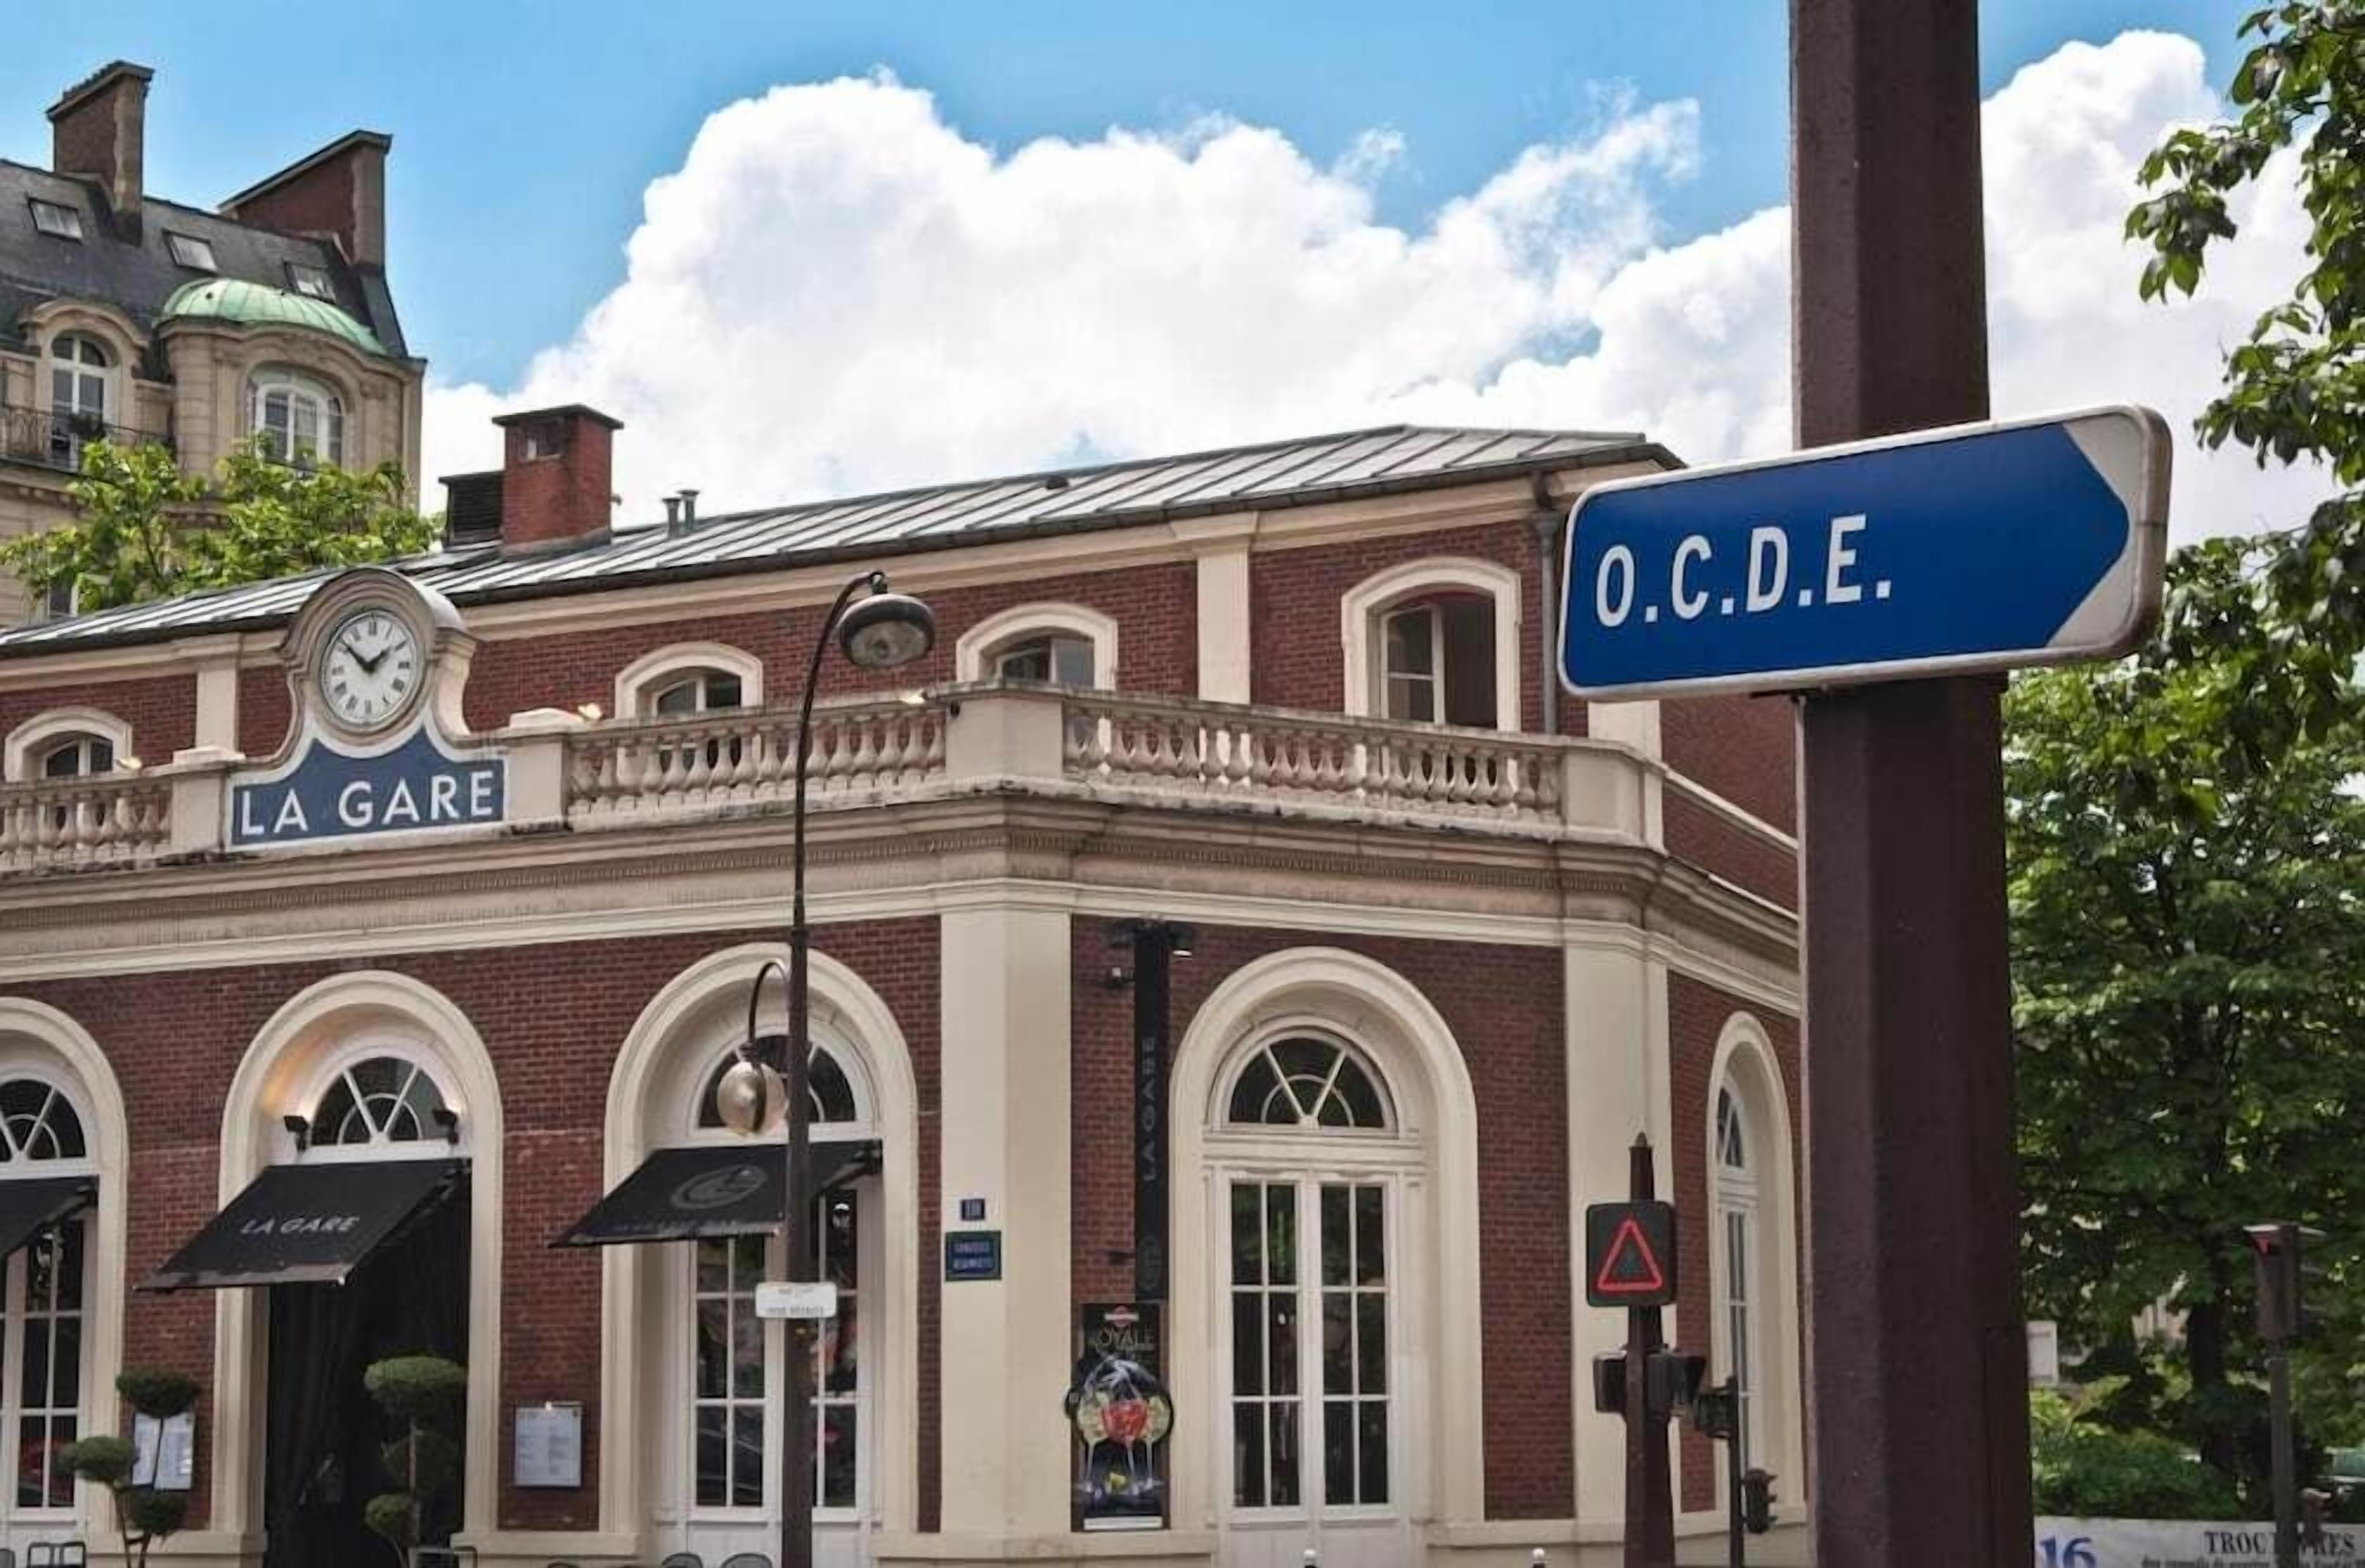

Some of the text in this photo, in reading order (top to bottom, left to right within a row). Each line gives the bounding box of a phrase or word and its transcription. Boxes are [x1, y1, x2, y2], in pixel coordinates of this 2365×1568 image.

[1596, 513, 1891, 627] O.C.D.E.
[241, 770, 493, 836] LA GARE
[239, 1215, 361, 1235] LA GARE
[2040, 1536, 2096, 1568] 16
